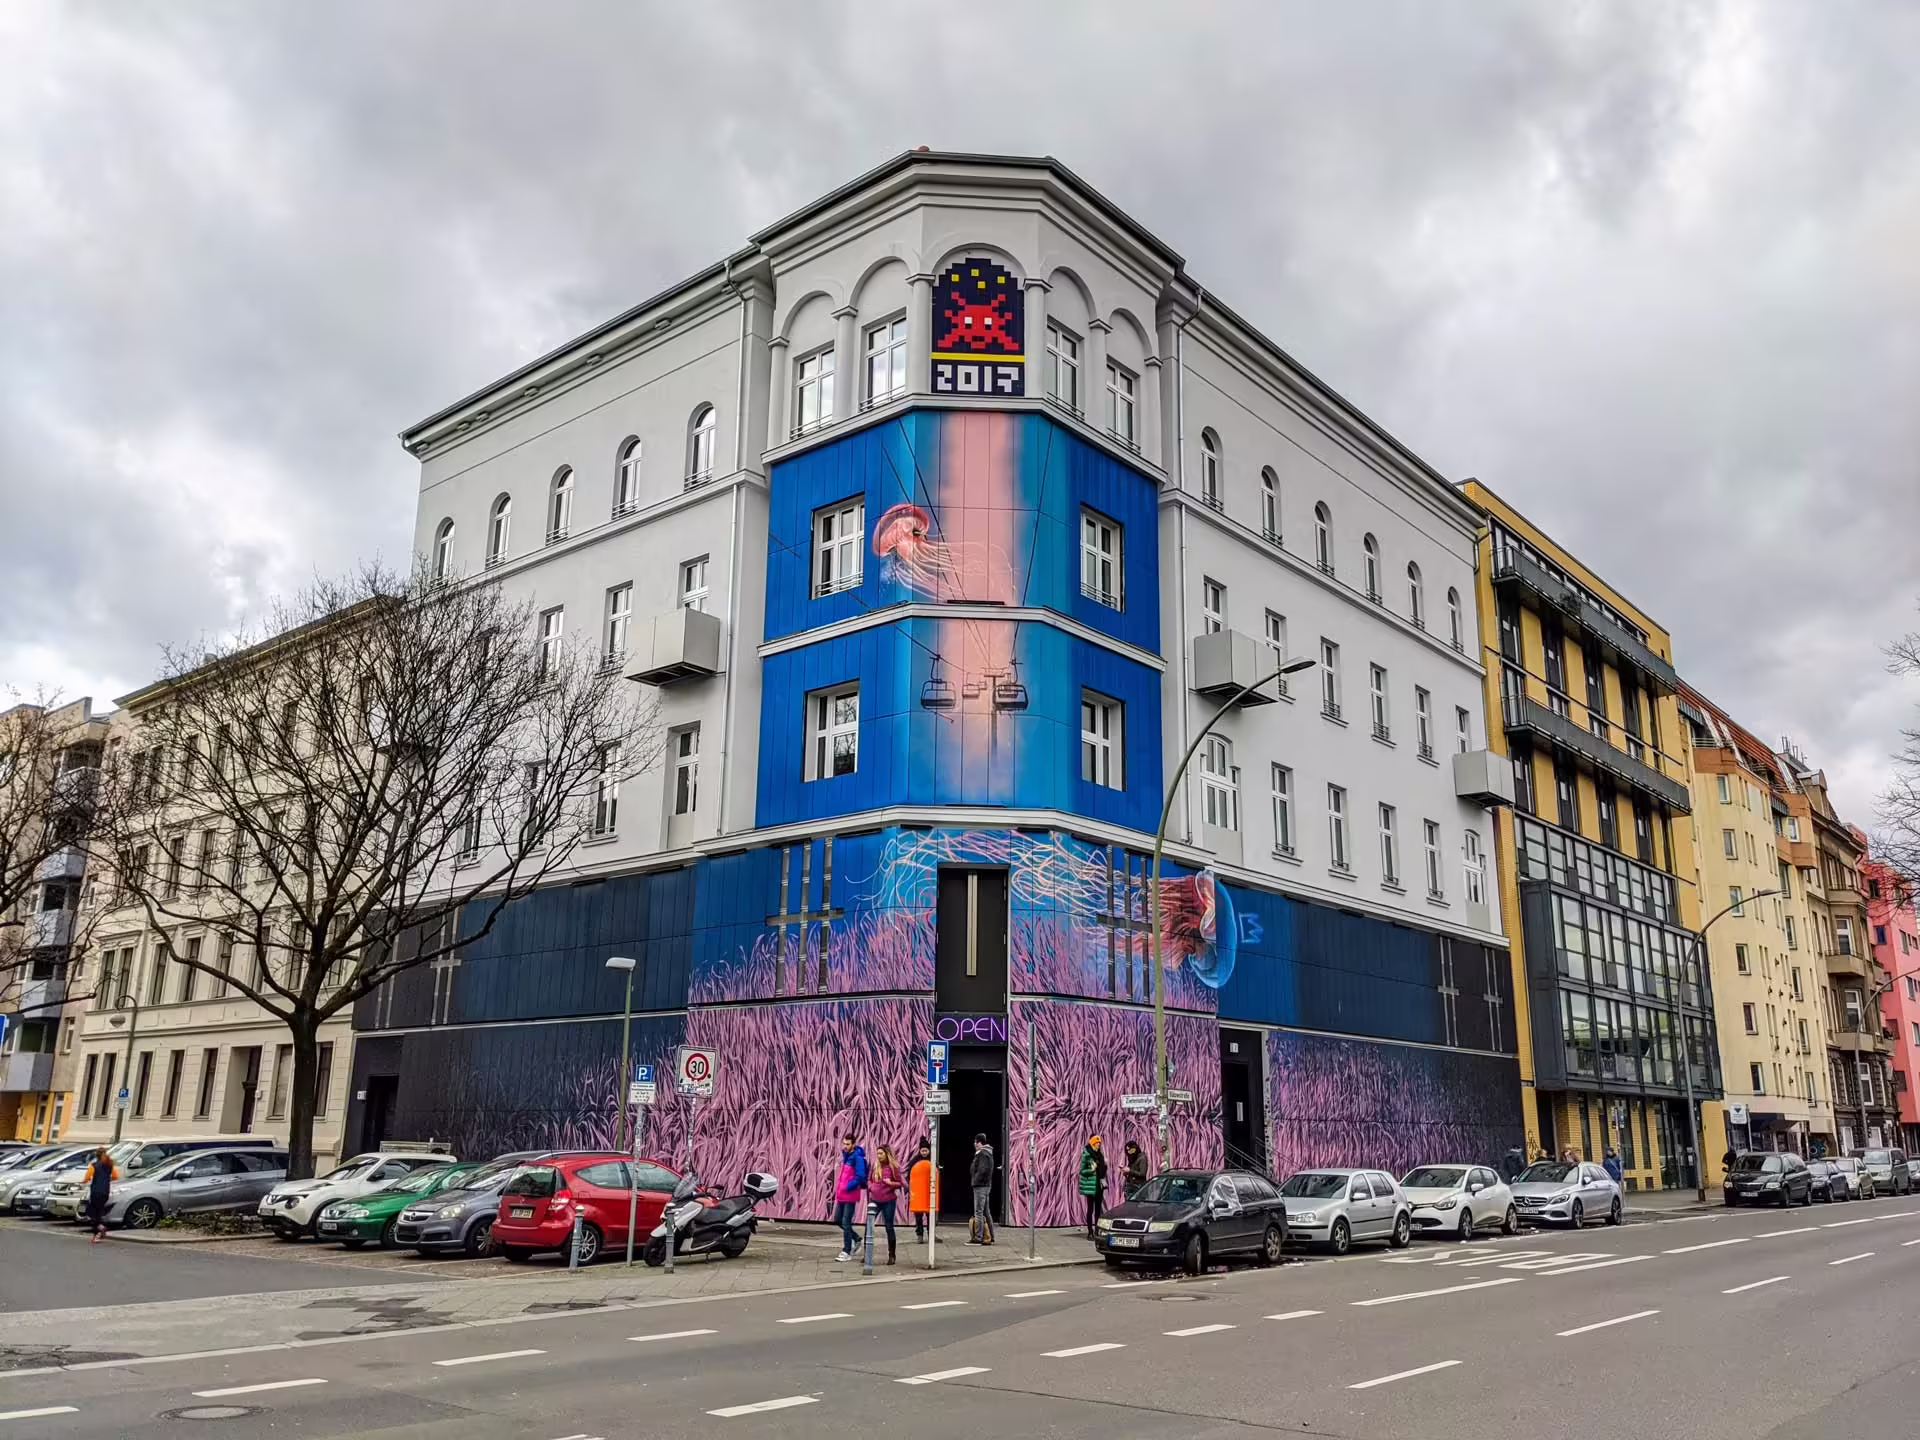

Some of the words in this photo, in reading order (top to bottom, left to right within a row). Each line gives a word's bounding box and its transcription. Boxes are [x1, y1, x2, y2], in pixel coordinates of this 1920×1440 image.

[937, 364, 1019, 393] 2017
[936, 1017, 1006, 1042] OPEN
[638, 1067, 648, 1081] P
[690, 1060, 705, 1075] 30
[1379, 1248, 1618, 1269] BUS
